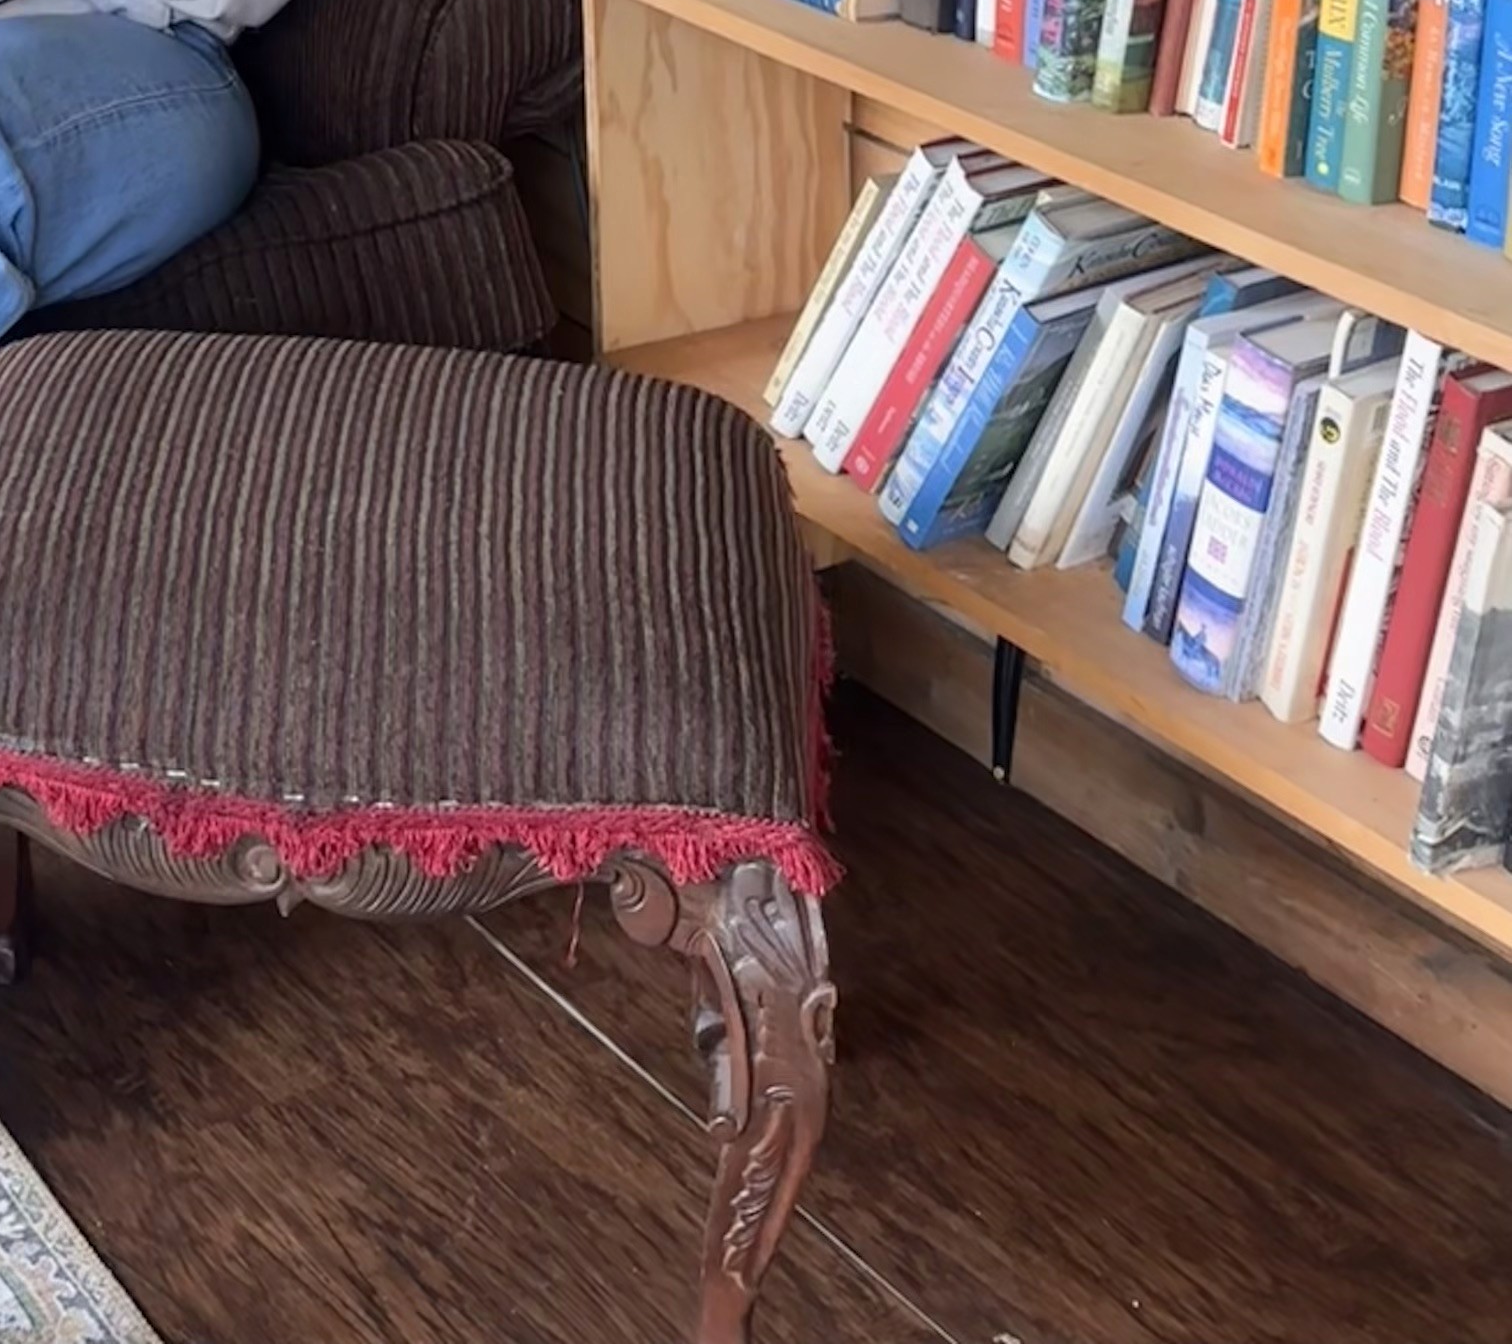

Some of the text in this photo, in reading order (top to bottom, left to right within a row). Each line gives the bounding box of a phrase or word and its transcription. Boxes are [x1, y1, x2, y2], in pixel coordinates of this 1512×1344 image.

[1350, 9, 1379, 90] Common
[1313, 46, 1345, 159] Mulberry Tree
[1490, 63, 1512, 110] New
[1345, 91, 1372, 125] Life
[1479, 116, 1510, 169] Song
[900, 171, 923, 197] The
[934, 179, 956, 205] The
[943, 197, 968, 226] The
[867, 228, 893, 257] and
[902, 235, 924, 262] and
[855, 257, 880, 285] The
[889, 261, 913, 288] The
[912, 253, 939, 285] and
[900, 282, 925, 310] The
[960, 324, 1000, 375] County
[1362, 355, 1427, 564] The Flood and The Blood
[1326, 677, 1358, 725] Deitz
